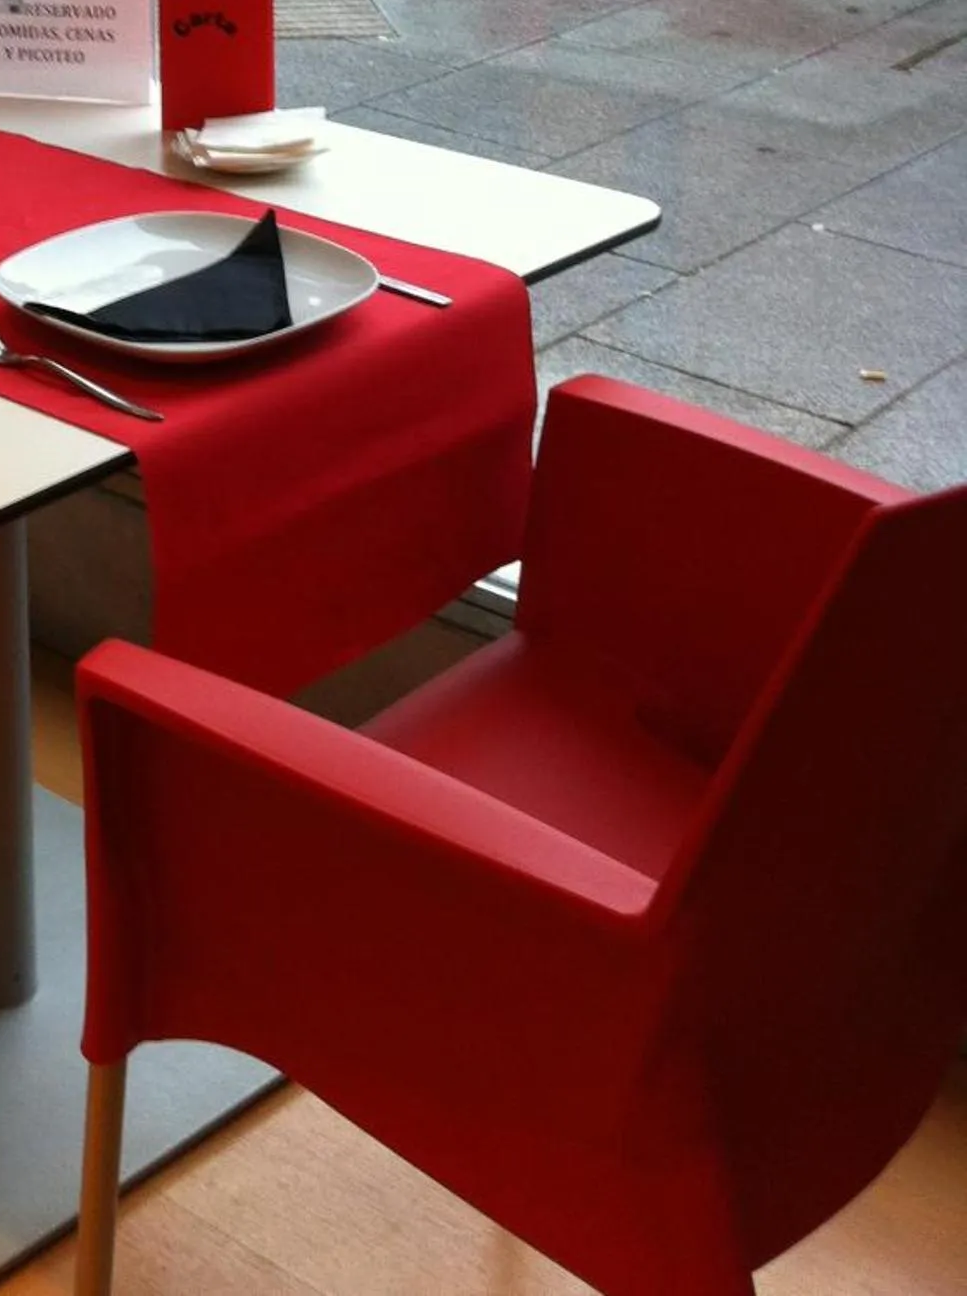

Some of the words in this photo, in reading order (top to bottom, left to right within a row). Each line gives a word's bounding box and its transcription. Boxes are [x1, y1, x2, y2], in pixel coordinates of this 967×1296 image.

[24, 3, 117, 20] RESERVADO
[65, 27, 116, 43] CENAS
[3, 47, 14, 61] Y
[18, 47, 86, 64] PICOTEO
